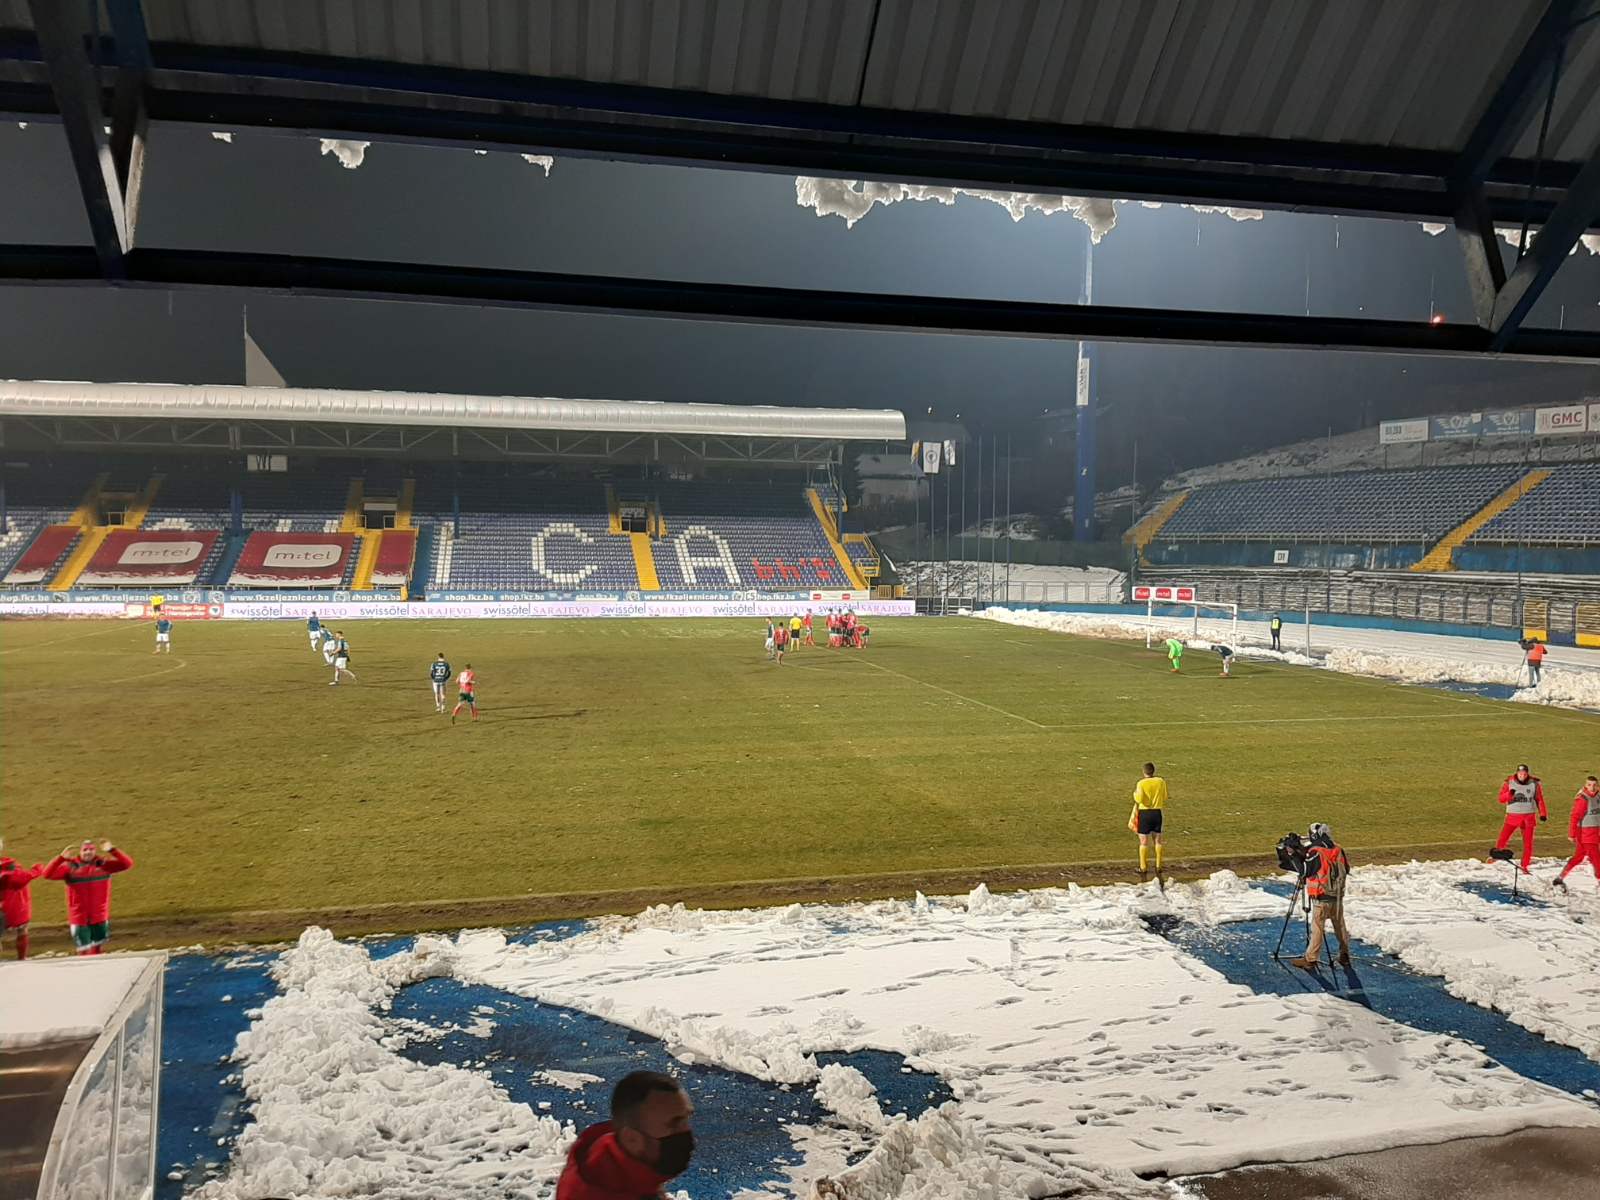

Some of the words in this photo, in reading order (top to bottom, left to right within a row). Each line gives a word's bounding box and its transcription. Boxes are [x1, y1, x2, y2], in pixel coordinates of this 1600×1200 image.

[1551, 411, 1583, 425] GMC
[132, 547, 192, 558] m:tel
[275, 550, 331, 561] m:tel
[531, 522, 598, 583] C
[674, 525, 742, 583] A
[0, 594, 49, 603] hop.fkz.ba
[75, 593, 179, 603] www.fkzeljeznic.ba
[757, 592, 796, 601] hop.fkz.ba
[231, 603, 283, 617] swissôtel
[360, 603, 410, 616] swissôtel
[483, 602, 532, 615] swissôtel
[600, 602, 647, 615] swissôtel
[712, 601, 756, 614] swissôtel
[435, 665, 446, 676] 33
